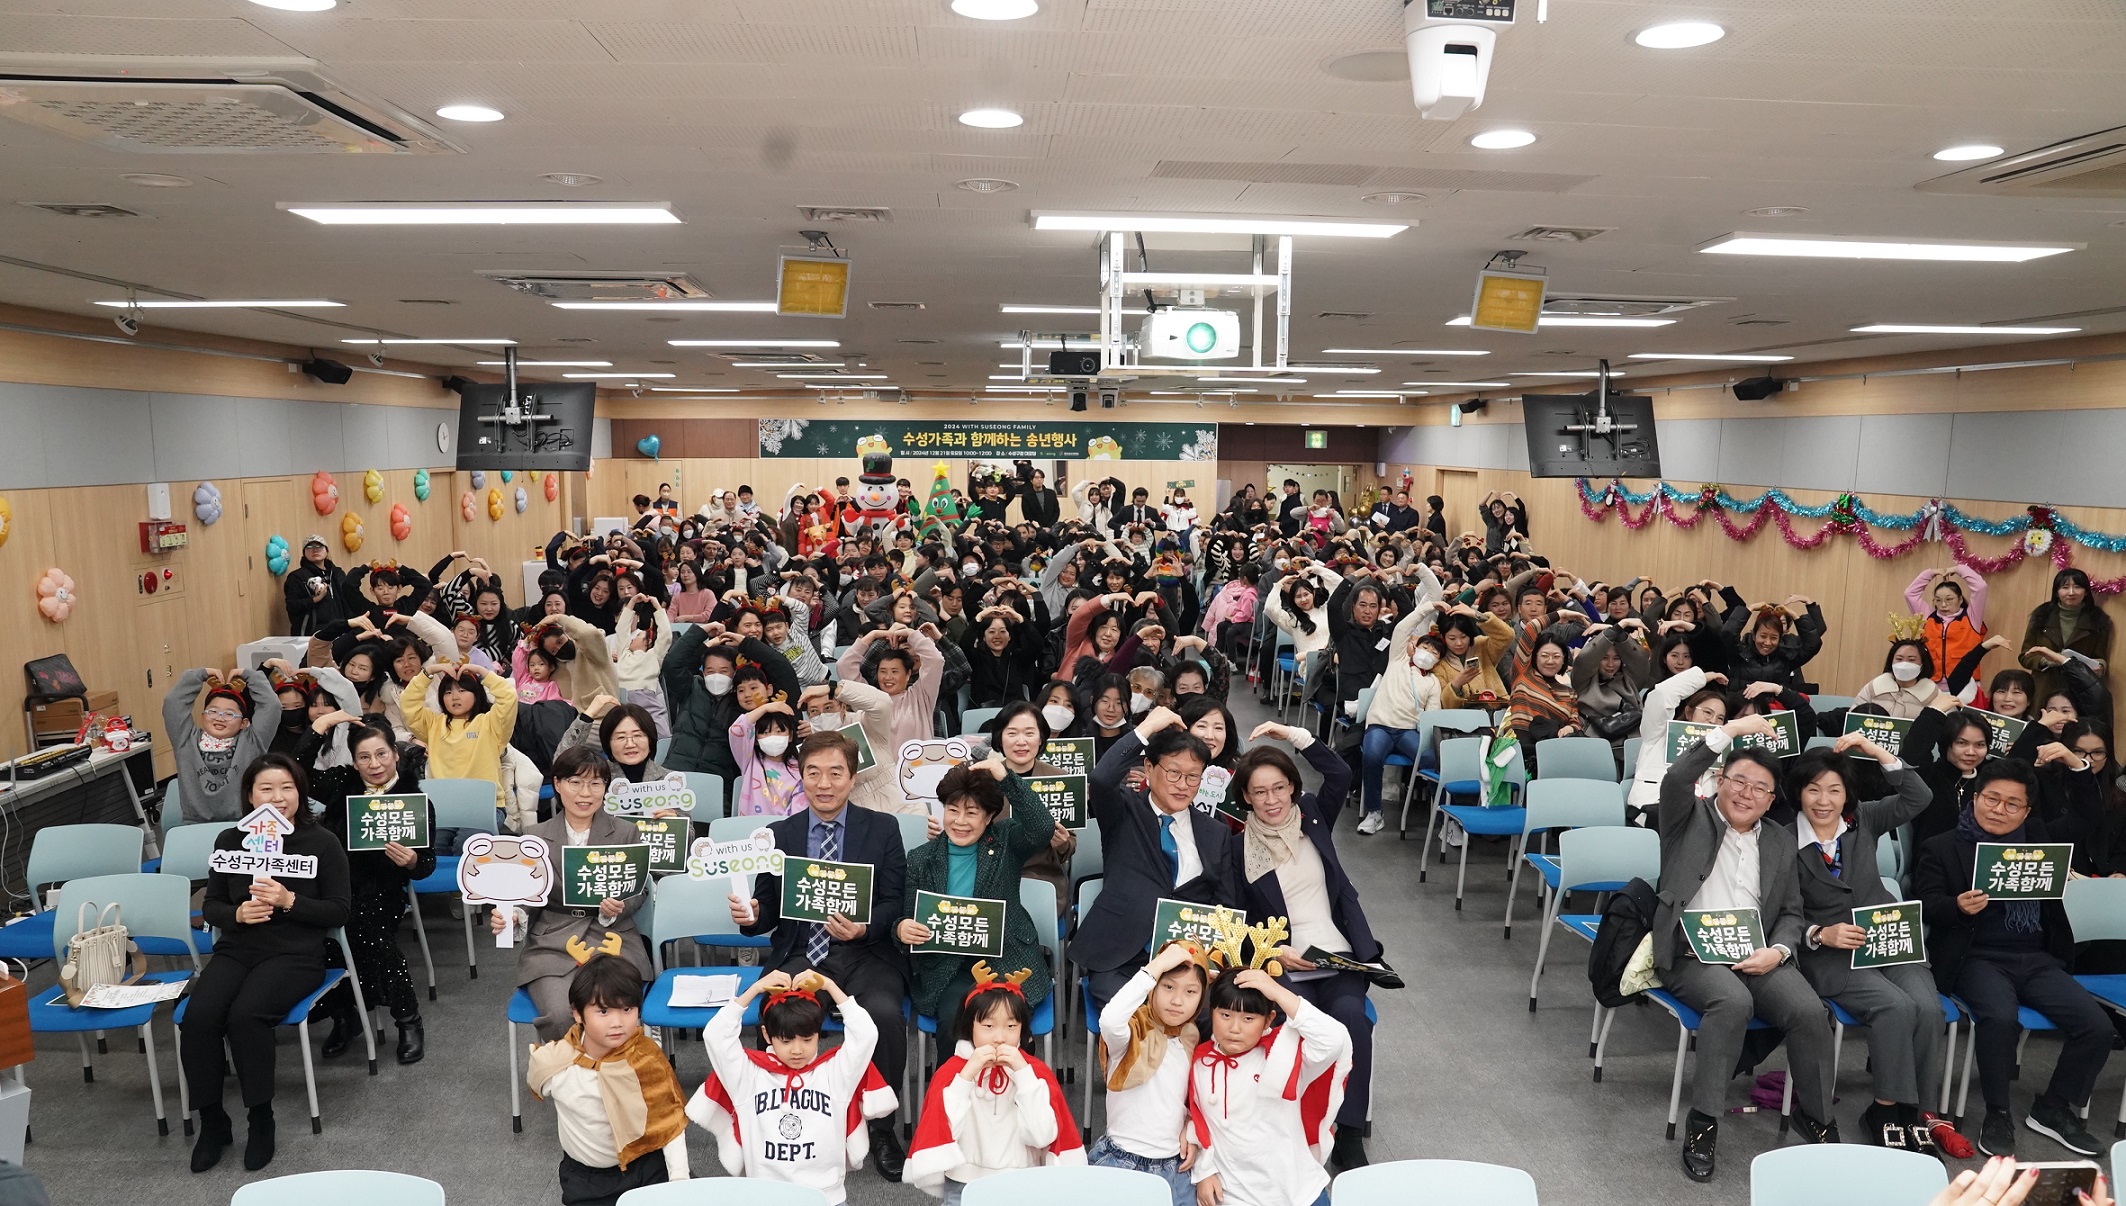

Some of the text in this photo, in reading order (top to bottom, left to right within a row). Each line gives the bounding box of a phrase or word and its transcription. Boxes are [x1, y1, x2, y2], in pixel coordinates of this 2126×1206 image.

[902, 431, 1078, 448] 수성가족과 함께하는 송년행사
[631, 784, 653, 793] with
[606, 794, 693, 812] Suseong
[360, 810, 416, 827] 수성모든
[249, 820, 277, 841] 가족
[360, 825, 416, 842] 가족함께
[246, 835, 279, 853] 센터
[716, 843, 752, 855] with us
[212, 853, 314, 875] 수성구가족센터
[577, 863, 637, 881] 수성모든
[690, 853, 783, 877] Suseong
[1990, 861, 2055, 877] 수성모든
[577, 879, 636, 898] 가족함께
[796, 876, 858, 900] 수성모든
[1988, 876, 2053, 892] 가족함께
[795, 893, 857, 916] 가족함께
[926, 913, 989, 933] 수성모든
[1866, 921, 1911, 942] 수성모든
[1697, 926, 1751, 943] 수성모든
[1702, 942, 1755, 960] 가족함께
[1865, 939, 1913, 959] 가족함께
[764, 1140, 816, 1161] DEPT.
